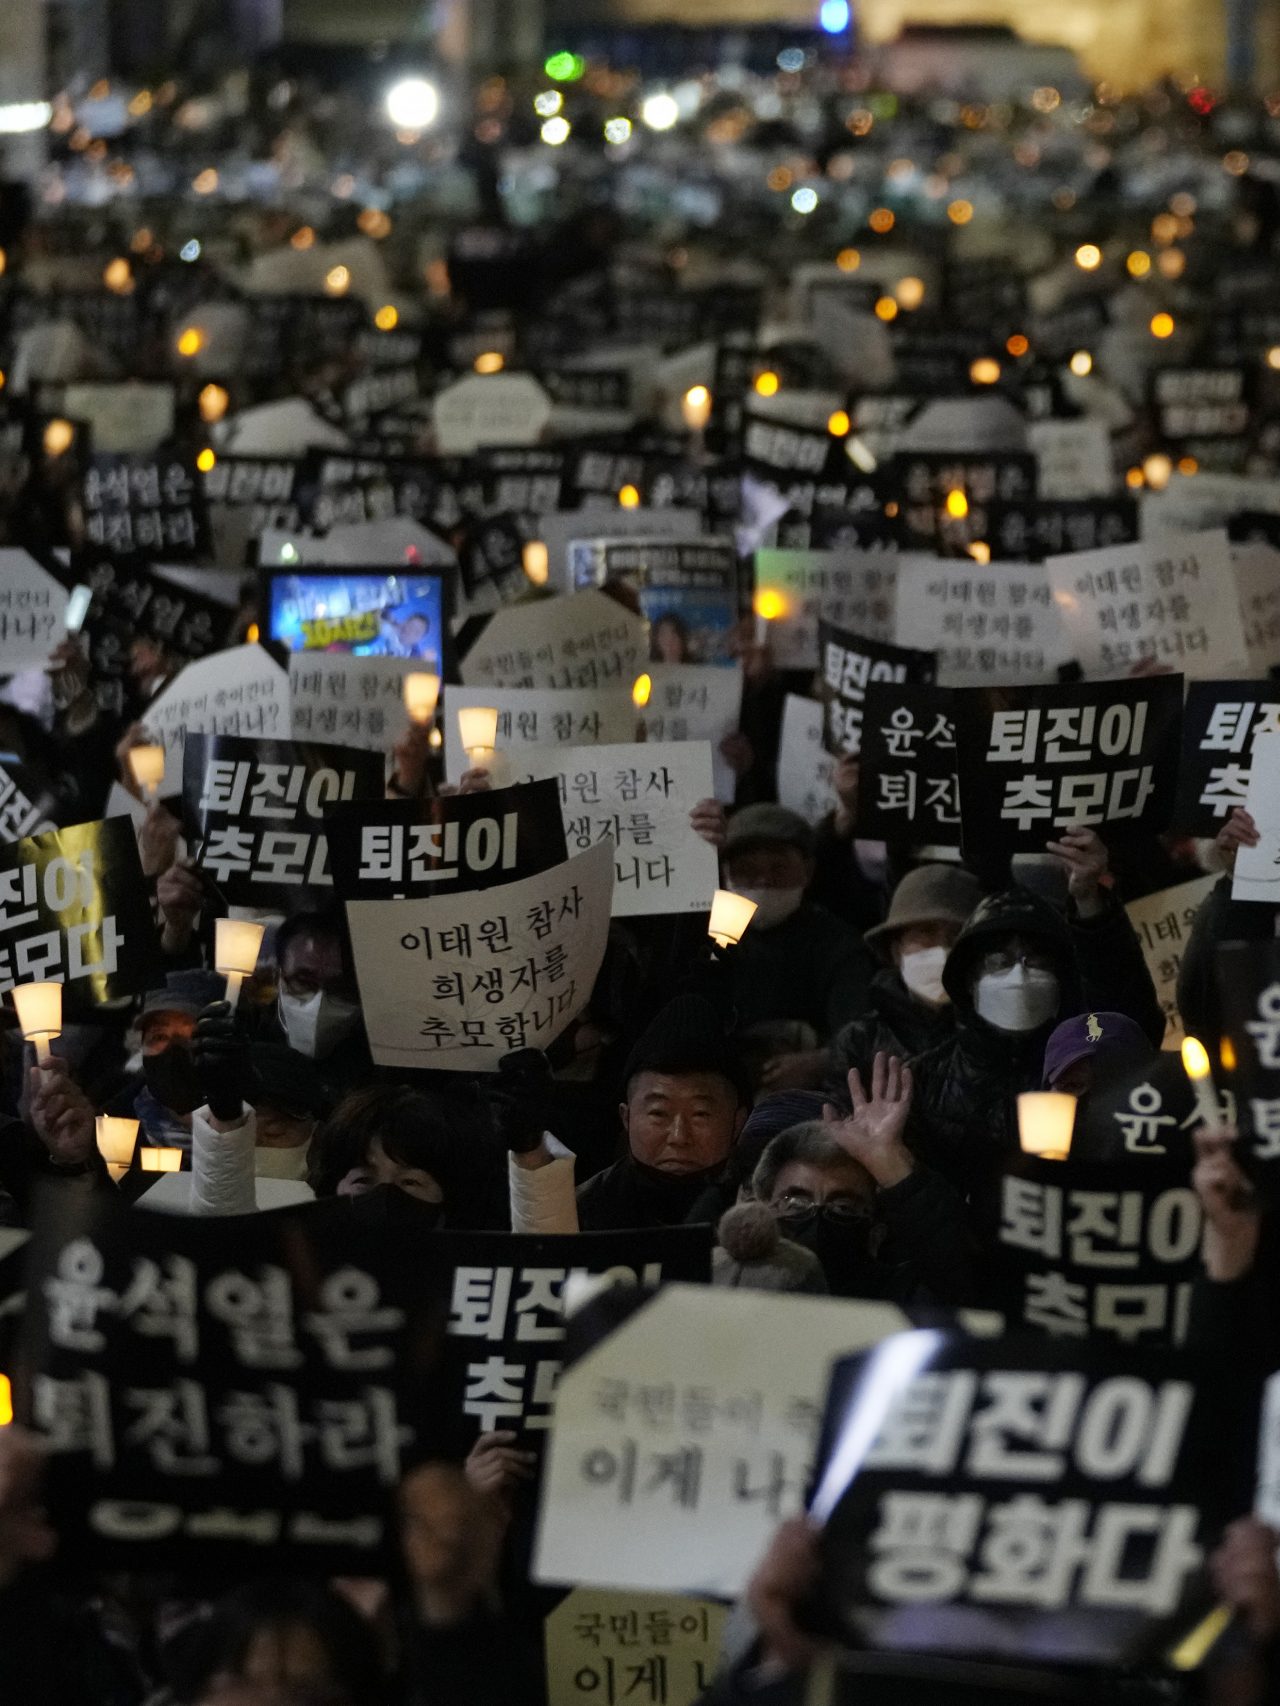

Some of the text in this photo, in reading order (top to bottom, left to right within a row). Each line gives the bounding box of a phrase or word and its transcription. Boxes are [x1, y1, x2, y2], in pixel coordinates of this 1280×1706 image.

[1075, 564, 1142, 598] 이태원
[1099, 595, 1190, 631] 희생자를
[552, 709, 602, 741] 참사
[986, 701, 1149, 765] 퇴진이
[199, 759, 357, 821] 퇴진이
[614, 766, 675, 803] 참사
[876, 771, 962, 824] 퇴진
[1000, 766, 1155, 831] 추모다
[358, 812, 520, 883] 퇴진이
[566, 811, 657, 850] 생자를
[0, 849, 96, 935] 진이
[401, 885, 584, 961] 이태원 참사
[432, 944, 569, 1006] 희생자를
[419, 979, 577, 1050] 추모합니다
[44, 1236, 408, 1372] 윤석열은
[1023, 1270, 1193, 1348] 추모
[28, 1370, 416, 1483] 퇴진하라
[862, 1366, 1196, 1488] 퇴진이
[579, 1436, 702, 1513] 이게
[864, 1489, 1204, 1616] 평화다
[573, 1598, 711, 1648] 국민들이
[573, 1653, 668, 1705] 이게
